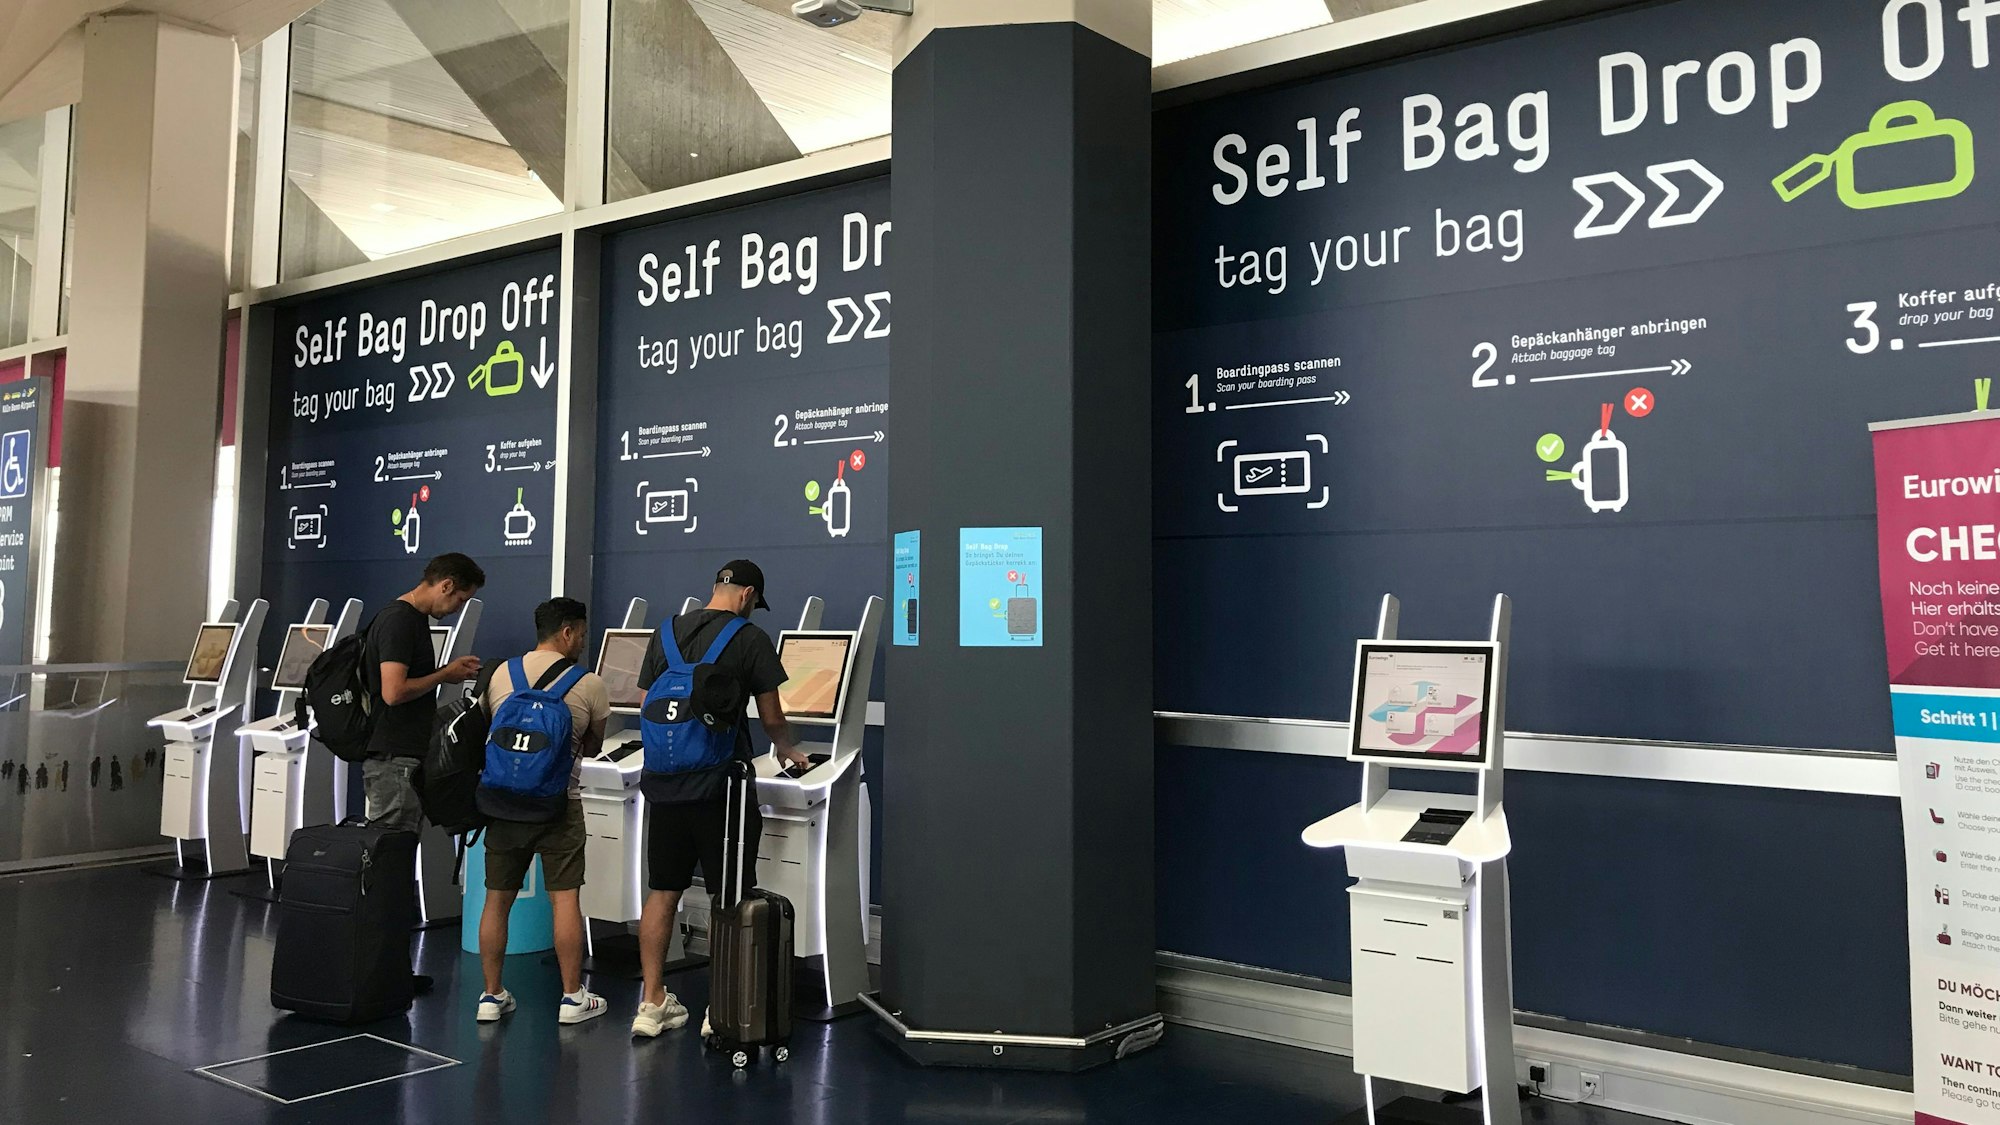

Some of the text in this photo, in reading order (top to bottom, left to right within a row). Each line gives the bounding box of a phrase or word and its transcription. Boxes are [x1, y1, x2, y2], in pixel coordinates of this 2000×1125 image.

[1212, 107, 1362, 206] Self
[1402, 90, 1550, 173] Bag
[1599, 37, 1822, 136] Drop
[638, 212, 892, 307] Self Bag Dr
[1214, 208, 1523, 295] tag your bag
[1898, 290, 1956, 308] Koffer
[294, 274, 554, 368] Self Bag Drop Off
[1899, 307, 1994, 326] drop your bag
[1511, 317, 1707, 350] Gepäckanhänger anbringen
[1846, 301, 1904, 354] 3.
[638, 317, 803, 375] tag your bag
[1511, 344, 1616, 363] Attach baggage tag
[1216, 357, 1341, 379] Boardingpass scannen
[1472, 341, 1516, 388] 2.
[1185, 373, 1216, 413] 1.
[1216, 374, 1317, 393] Scan your boarding pass
[293, 379, 395, 422] tag your bag
[795, 406, 853, 421] Gepäckanhänger
[638, 421, 707, 436] Boardingpass scannen
[774, 414, 797, 447] 2.
[794, 419, 848, 431] Attach baggage tag
[500, 438, 542, 450] Koffer aufgeben
[620, 430, 638, 461] 1.
[638, 438, 649, 446] Scan
[650, 437, 660, 446] your
[485, 444, 501, 473] 3.
[280, 465, 292, 490] 1.
[374, 456, 389, 482] 2.
[1903, 467, 2000, 499] Eurowi
[0, 530, 24, 547] ervice
[1906, 524, 2000, 562] CHE
[1909, 580, 2000, 596] Noch keine
[1911, 601, 1943, 616] Hier
[1913, 621, 1999, 637] Don't have
[1914, 641, 2000, 657] Get it here
[666, 700, 678, 721] 5
[1920, 708, 1976, 727] Schritt
[1979, 711, 1987, 727] 1
[512, 733, 530, 752] 11
[1953, 756, 1974, 765] Nutze
[1955, 775, 1968, 783] Use
[1969, 776, 1982, 784] the
[1957, 821, 1985, 832] Choose
[1960, 861, 1978, 870] Enter
[1980, 864, 1992, 873] the
[1961, 889, 1987, 900] Drucke
[1962, 901, 1978, 909] Print
[1980, 904, 1996, 912] your
[1961, 928, 1984, 940] Bringe
[1961, 940, 1986, 950] Attach
[1938, 978, 1957, 993] DU
[1938, 1001, 1964, 1014] Dann
[1965, 1008, 1997, 1021] weiter
[1939, 1013, 1960, 1026] Bitte
[1962, 1019, 1987, 1032] gehe
[1941, 1053, 1983, 1074] WANT
[1941, 1076, 1965, 1090] Then
[1941, 1088, 1974, 1104] Please
[1976, 1097, 1989, 1108] go
